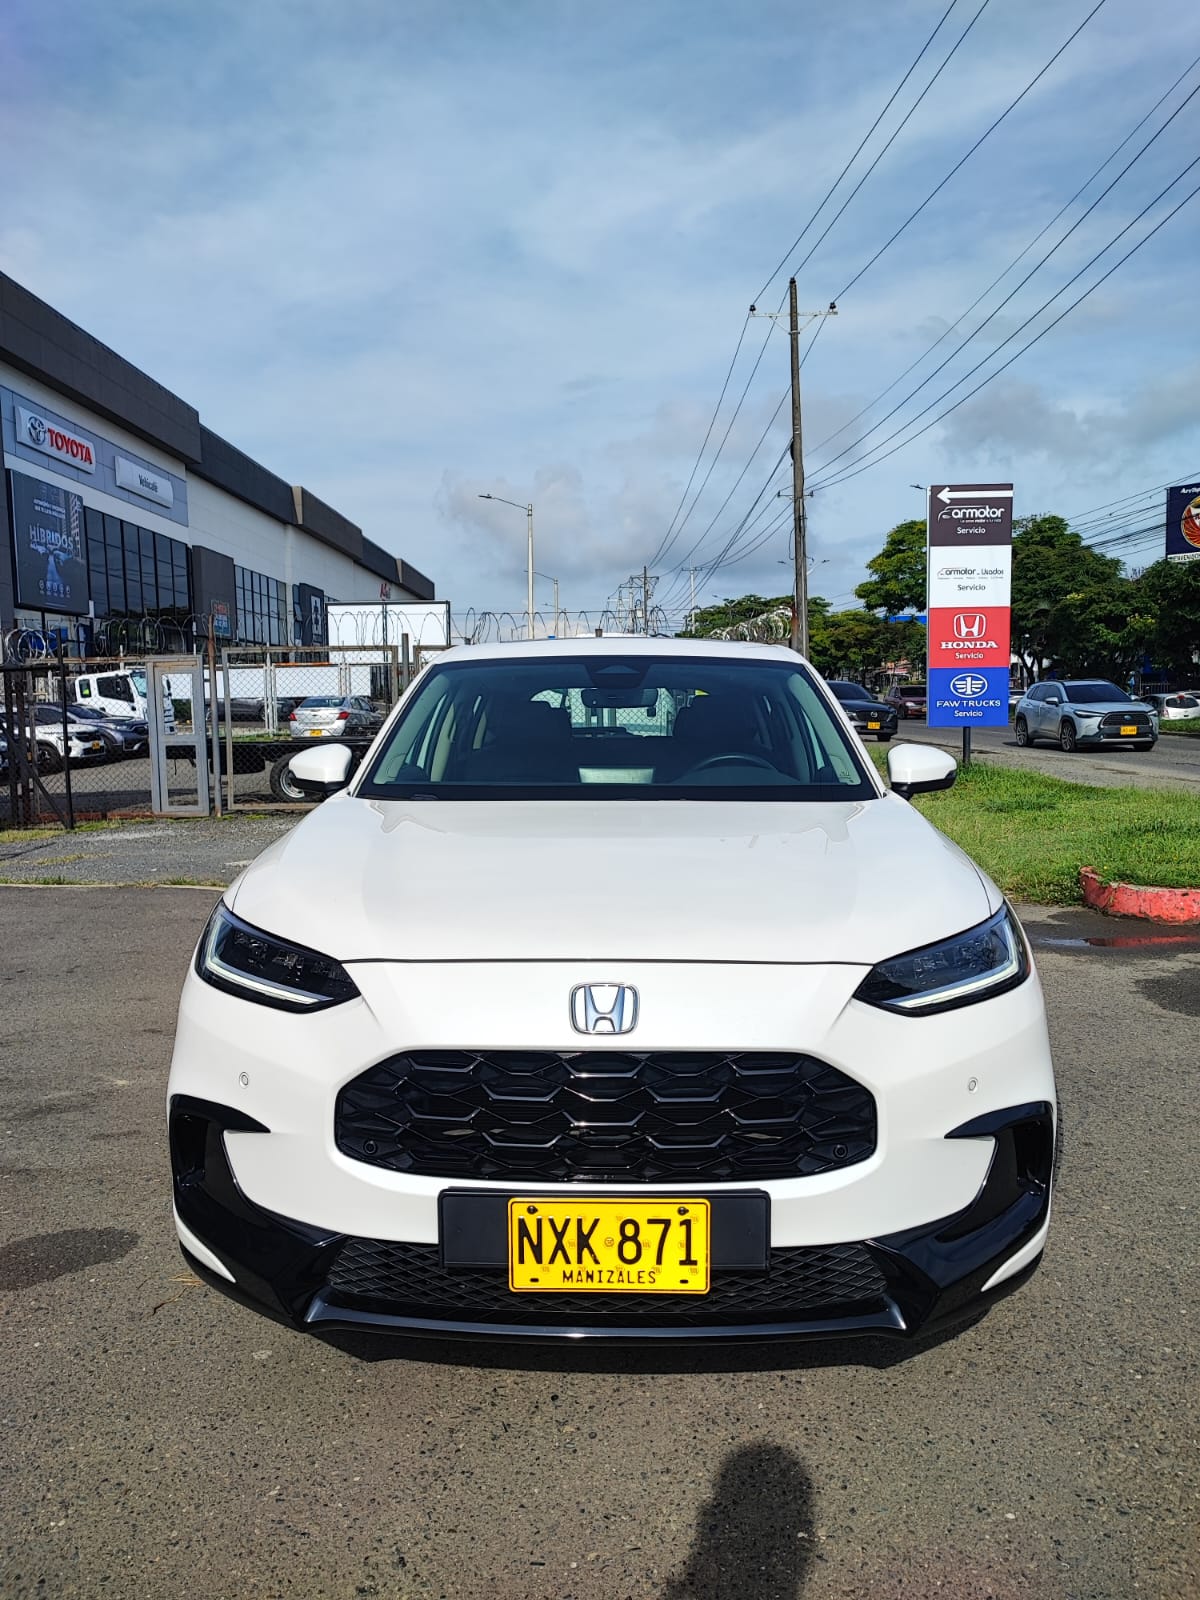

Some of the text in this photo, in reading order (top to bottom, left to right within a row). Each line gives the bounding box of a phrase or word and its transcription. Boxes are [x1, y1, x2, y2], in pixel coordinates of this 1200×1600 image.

[47, 428, 93, 464] TOYOTA
[956, 526, 986, 534] Servicio
[29, 523, 74, 550] HÍBRIDOS
[957, 583, 986, 591] Servicio
[940, 641, 999, 649] HONDA
[936, 699, 1001, 708] FAW TRUCKS
[954, 709, 983, 717] Servicio
[517, 1216, 698, 1266] NXK 871
[562, 1270, 656, 1284] MANIZALES
